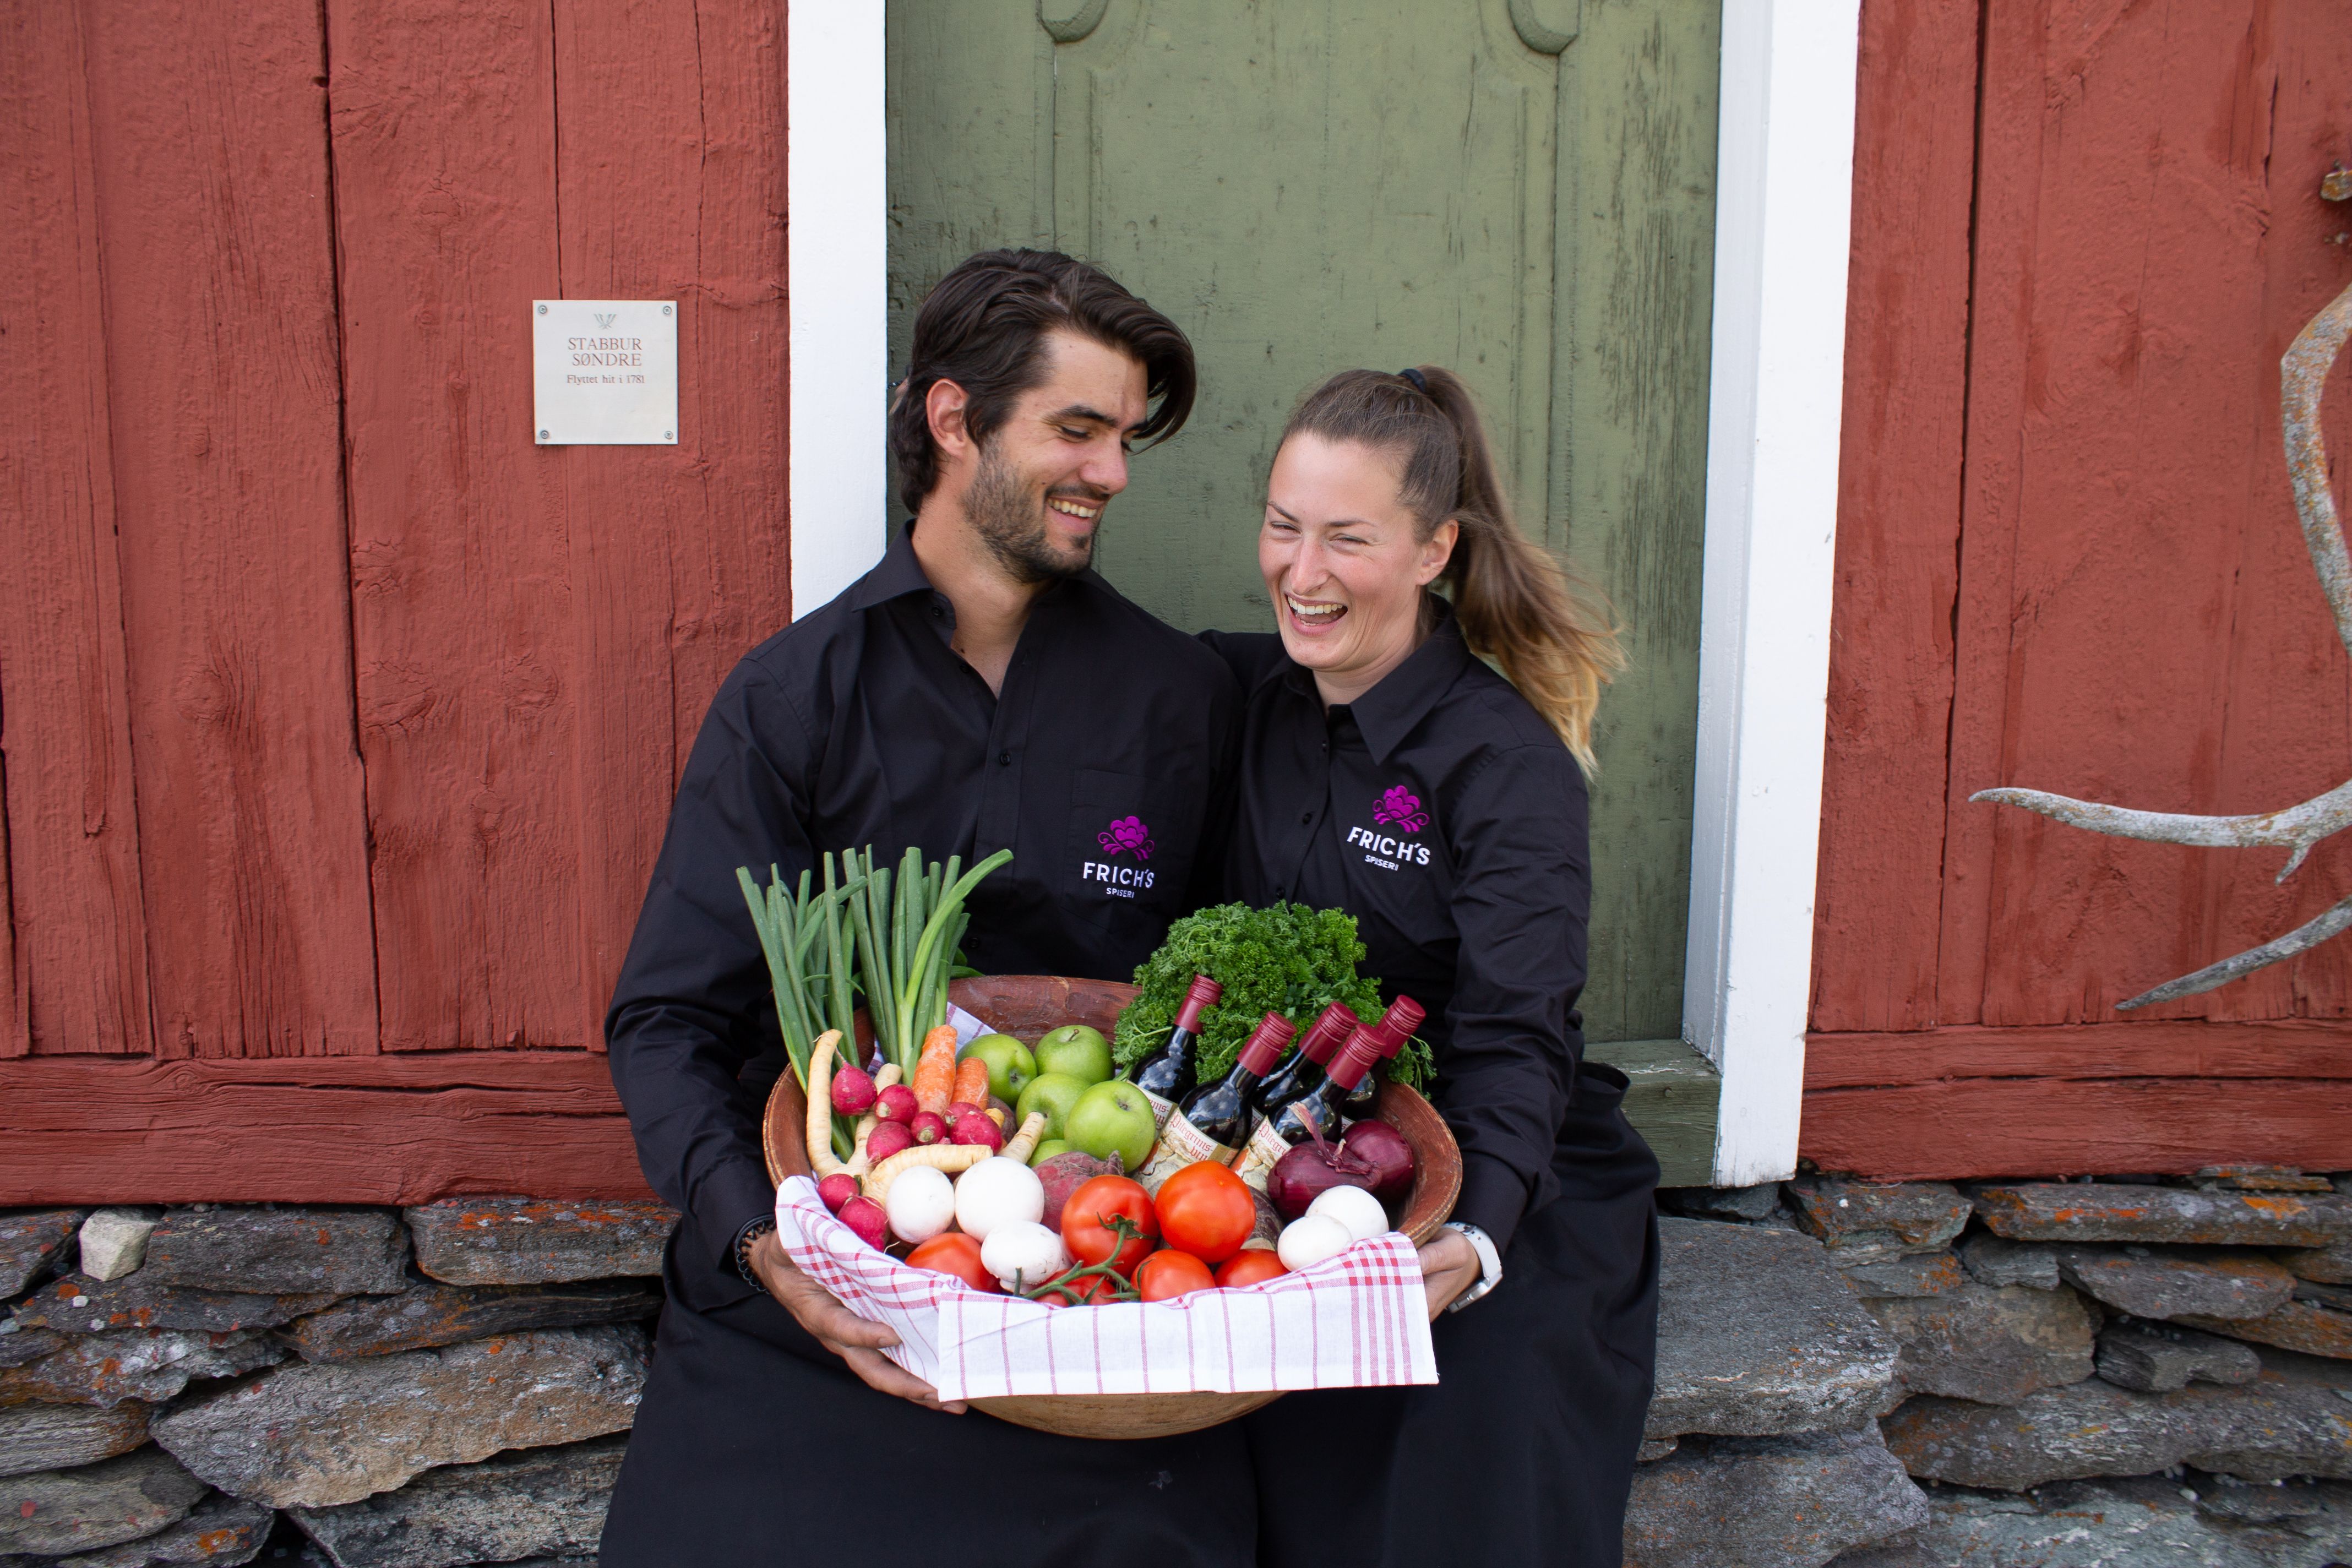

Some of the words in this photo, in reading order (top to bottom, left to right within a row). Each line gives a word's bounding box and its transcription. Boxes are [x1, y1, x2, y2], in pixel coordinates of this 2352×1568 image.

[568, 337, 642, 350] STABBUR
[573, 353, 642, 366] SØNDRE
[567, 374, 598, 385] Flyttet
[602, 375, 615, 383] hit
[619, 375, 623, 383] i
[626, 375, 645, 384] 1781
[1364, 854, 1400, 872] SPISERI
[1106, 888, 1135, 899] SPISERI
